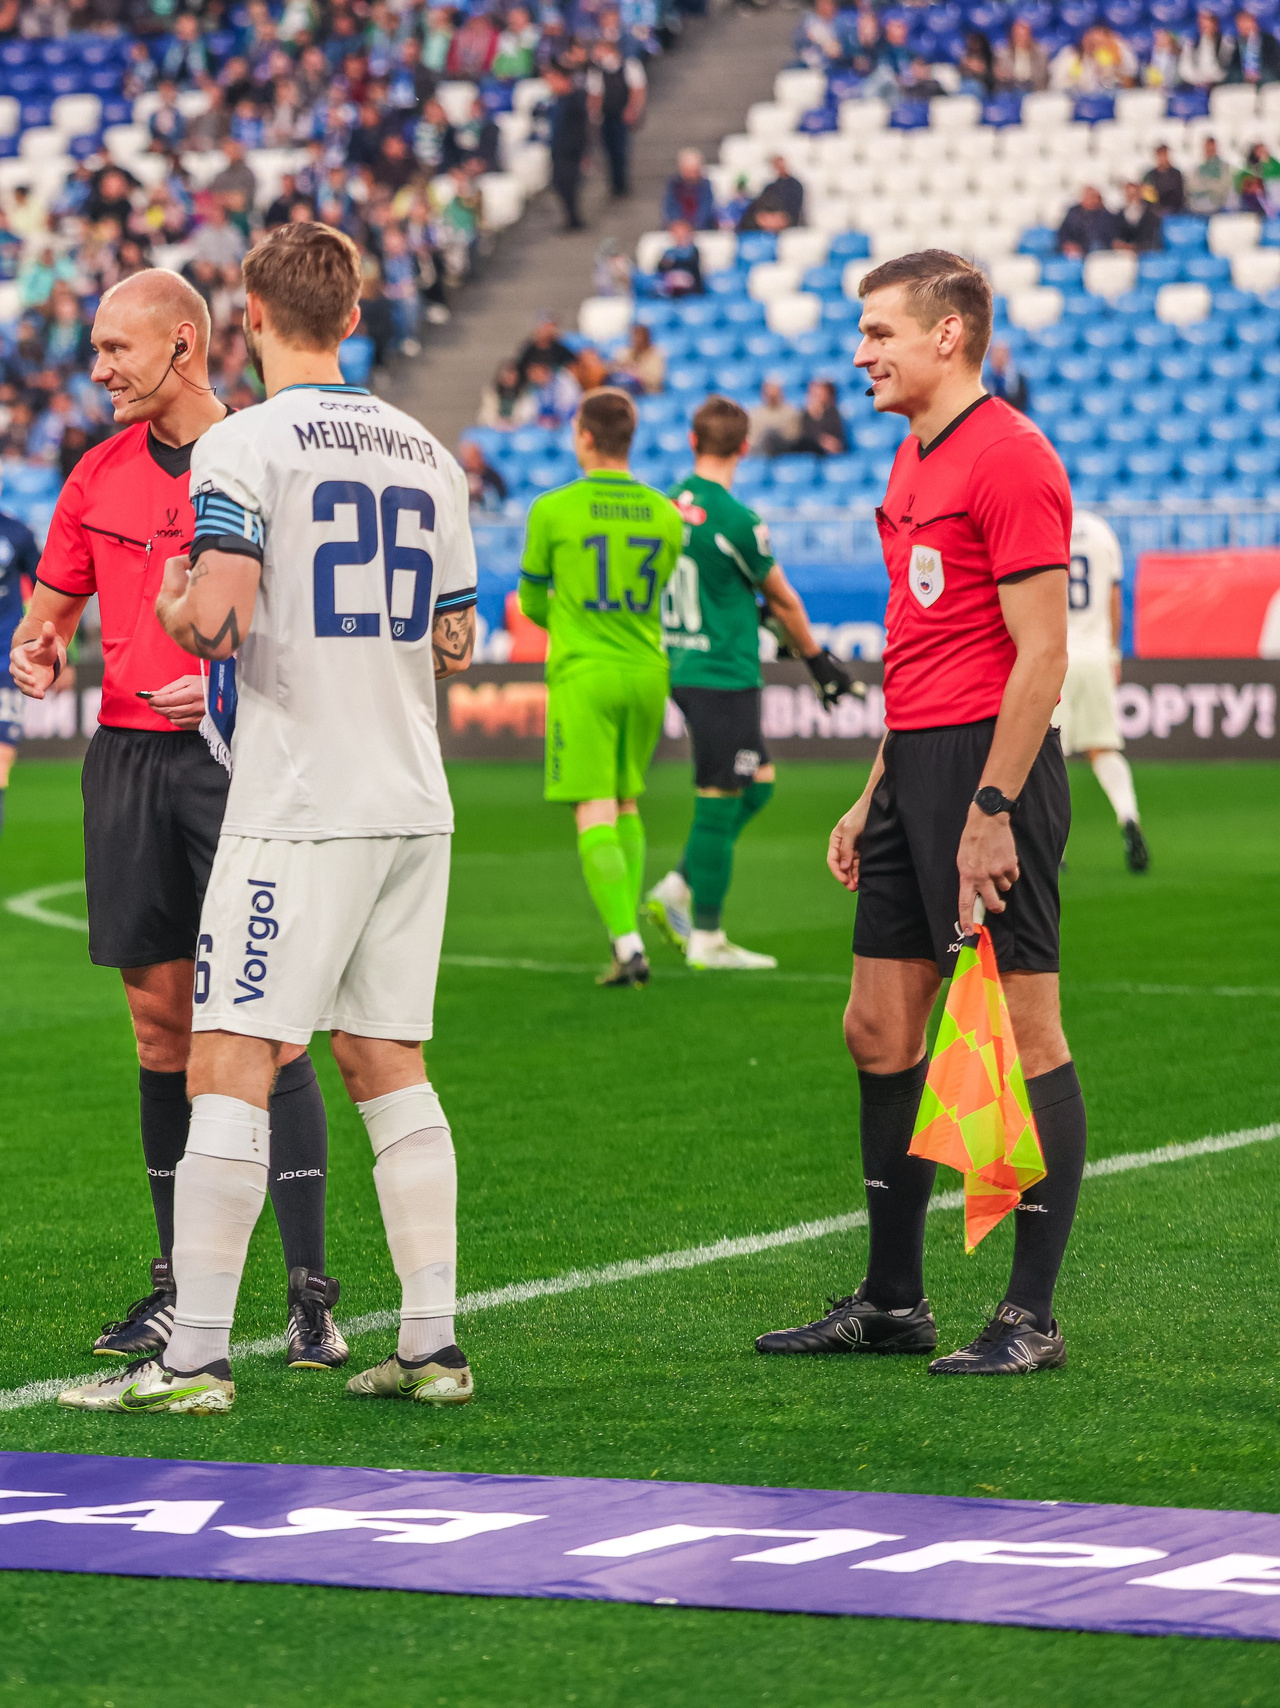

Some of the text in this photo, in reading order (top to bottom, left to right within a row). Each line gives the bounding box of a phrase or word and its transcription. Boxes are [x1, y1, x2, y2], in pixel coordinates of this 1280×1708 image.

[293, 421, 437, 469] МЕЩАНИНОВ
[320, 402, 379, 415] спорт
[313, 480, 435, 642] 26
[583, 534, 662, 613] 13
[233, 878, 279, 1005] Vorgol
